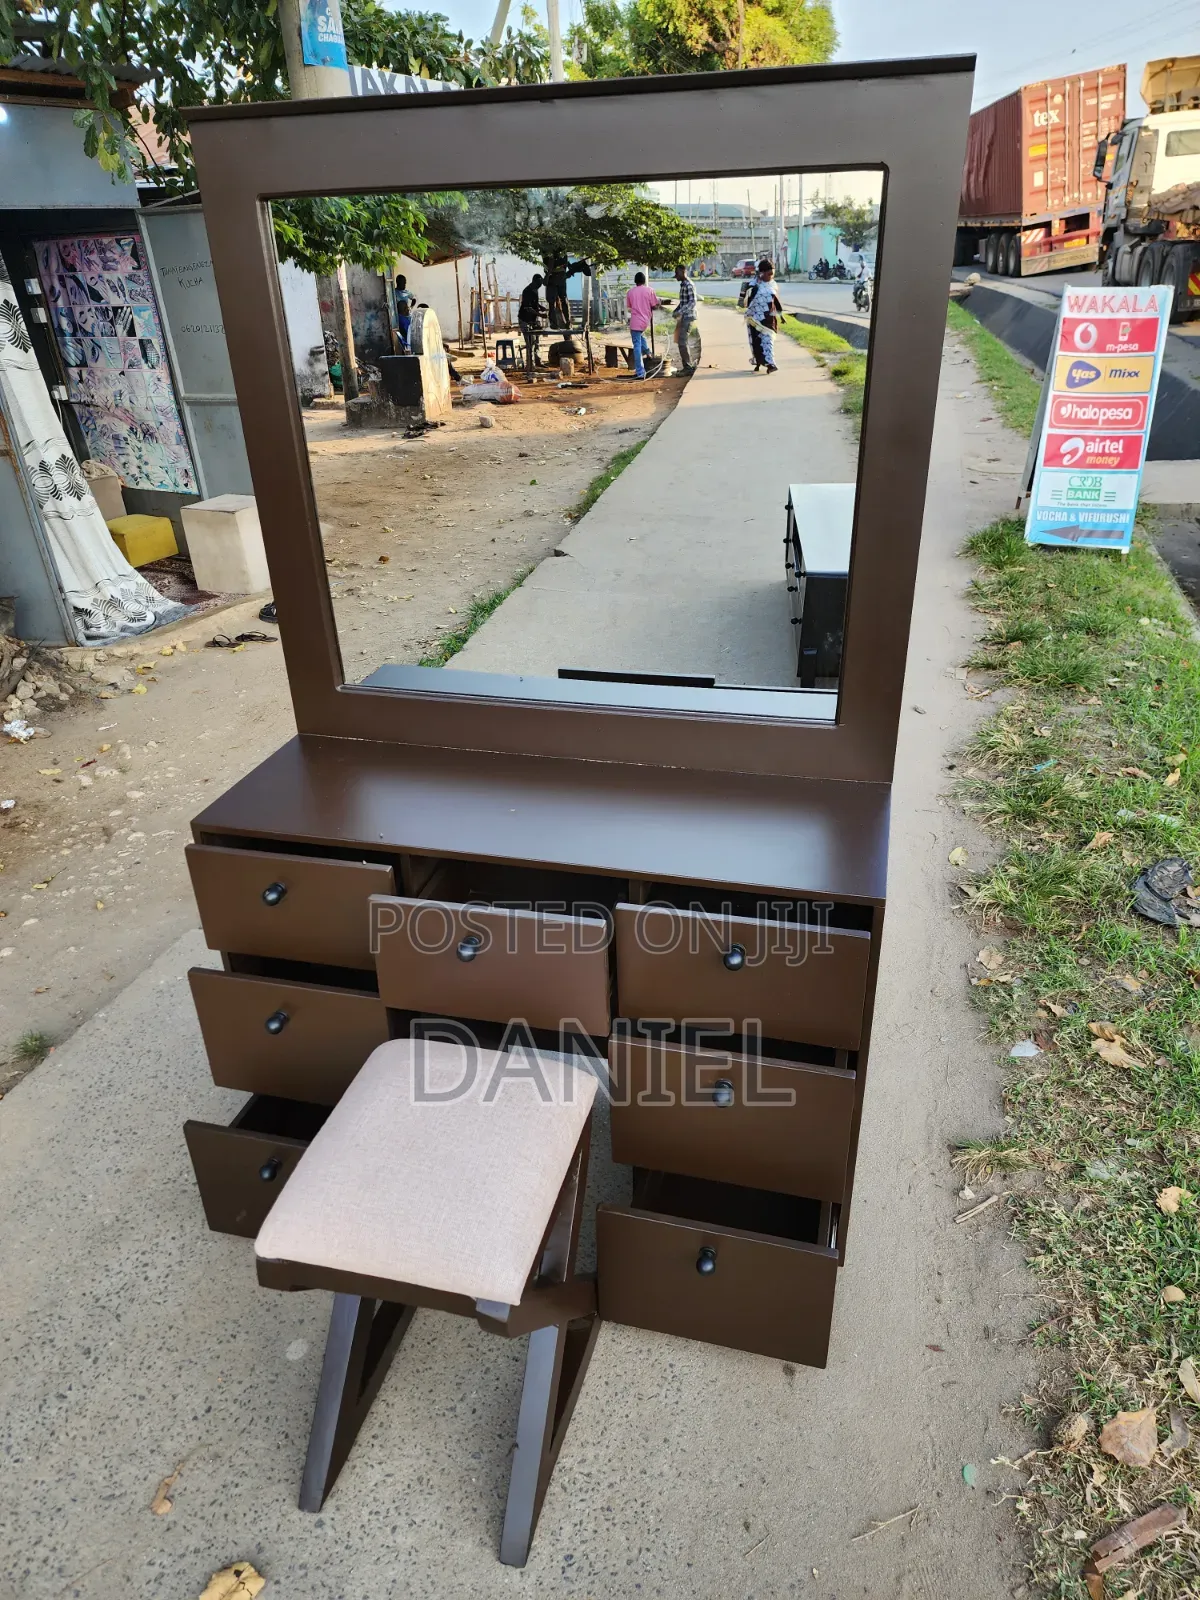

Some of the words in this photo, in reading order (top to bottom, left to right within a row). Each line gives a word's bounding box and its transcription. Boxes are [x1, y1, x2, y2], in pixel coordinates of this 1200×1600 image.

[1034, 110, 1060, 128] tex
[1067, 294, 1159, 314] WAKALA
[1106, 343, 1139, 353] m-pesa
[1072, 368, 1096, 383] yas
[1071, 404, 1133, 426] halopesa
[1085, 437, 1124, 454] airtel
[1086, 456, 1120, 467] money
[1066, 490, 1101, 501] BANK
[1036, 510, 1068, 522] VOCHA
[1070, 512, 1077, 522] &
[1079, 512, 1130, 524] VIFURUSHI
